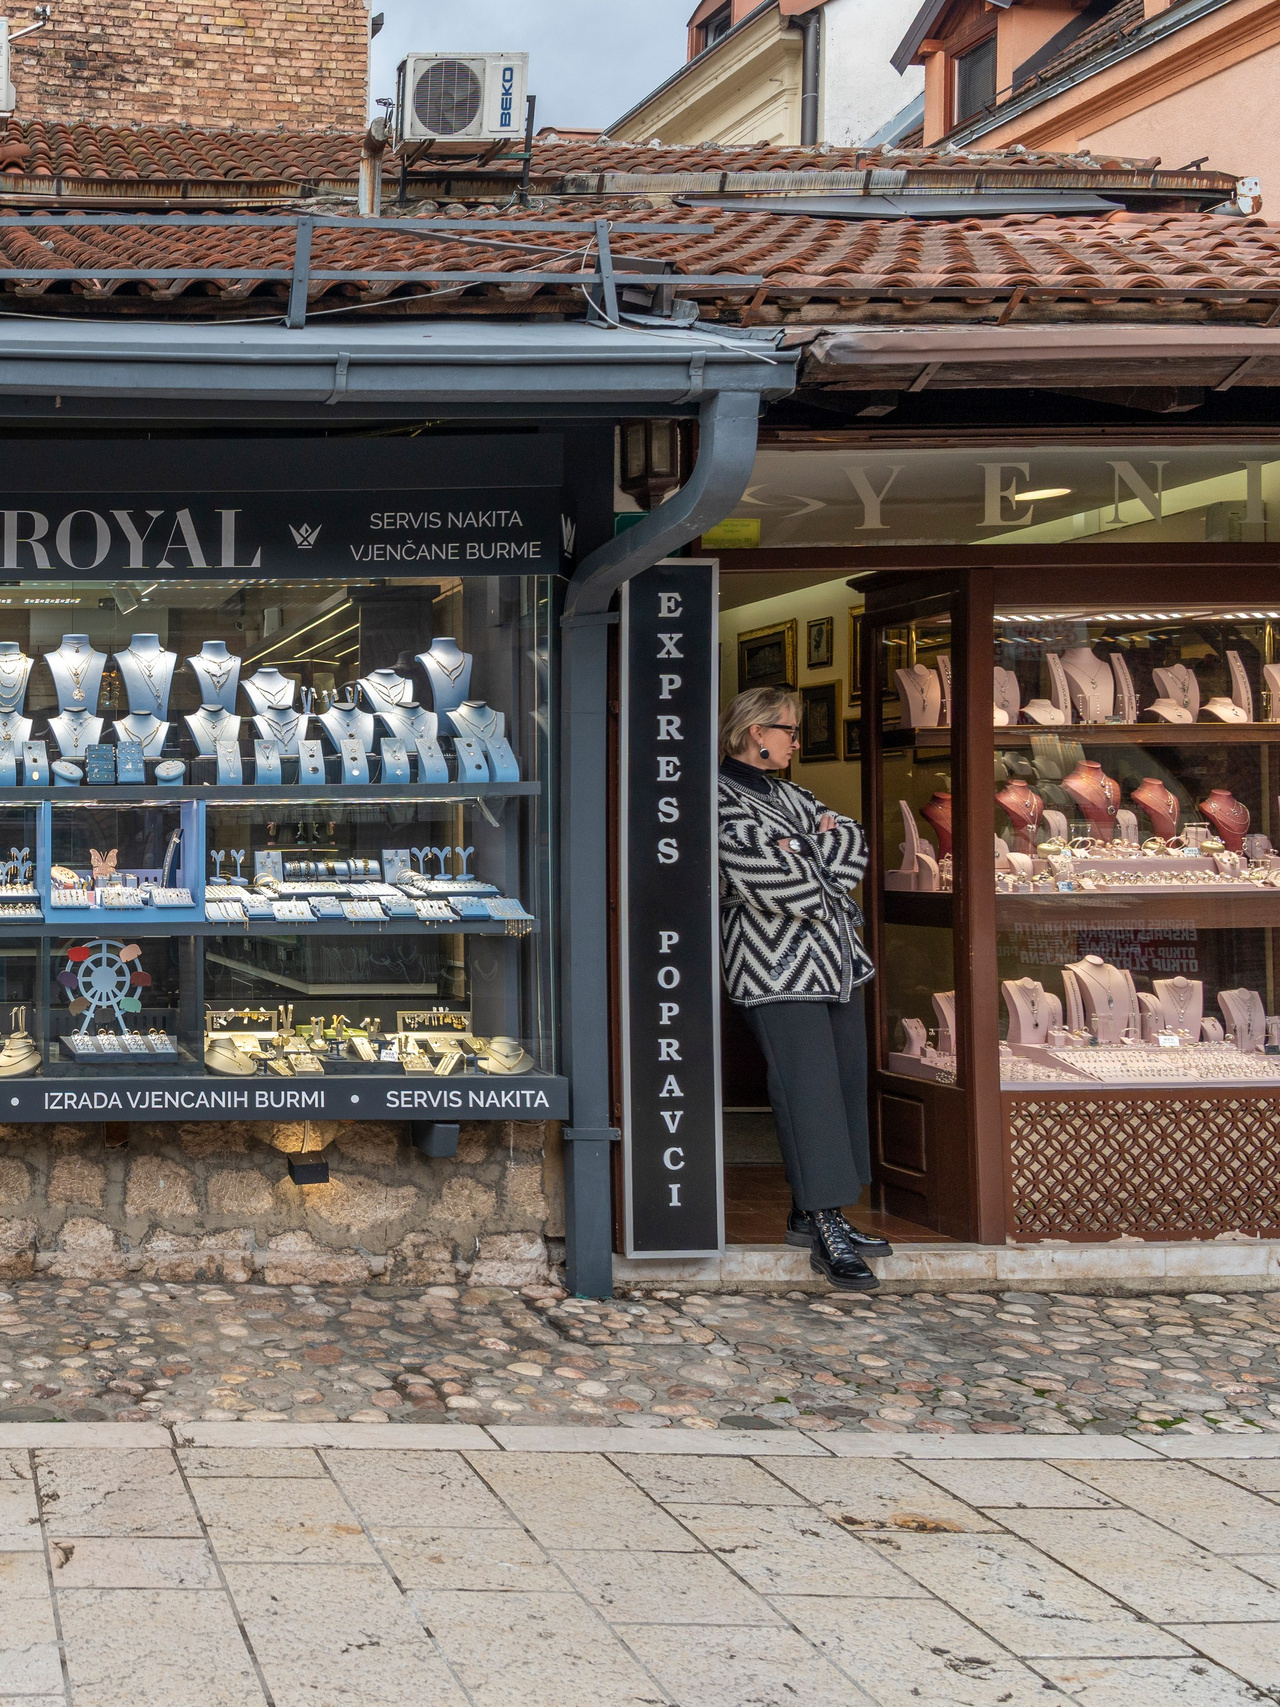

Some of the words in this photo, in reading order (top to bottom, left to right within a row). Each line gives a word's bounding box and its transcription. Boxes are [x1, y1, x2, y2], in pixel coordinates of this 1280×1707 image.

[500, 67, 513, 127] BEKO
[370, 512, 442, 530] SERVIS
[448, 510, 523, 528] NAKITA
[350, 540, 460, 561] VJENČANE
[466, 542, 542, 560] BURME
[656, 592, 684, 864] EXPRESS
[656, 930, 686, 1207] POPRAVCI
[44, 1092, 122, 1110] IZRADA
[126, 1091, 248, 1109] VJENCANIH
[255, 1090, 325, 1108] BURMI
[386, 1090, 462, 1108] SERVIS
[469, 1090, 550, 1108] NAKITA
